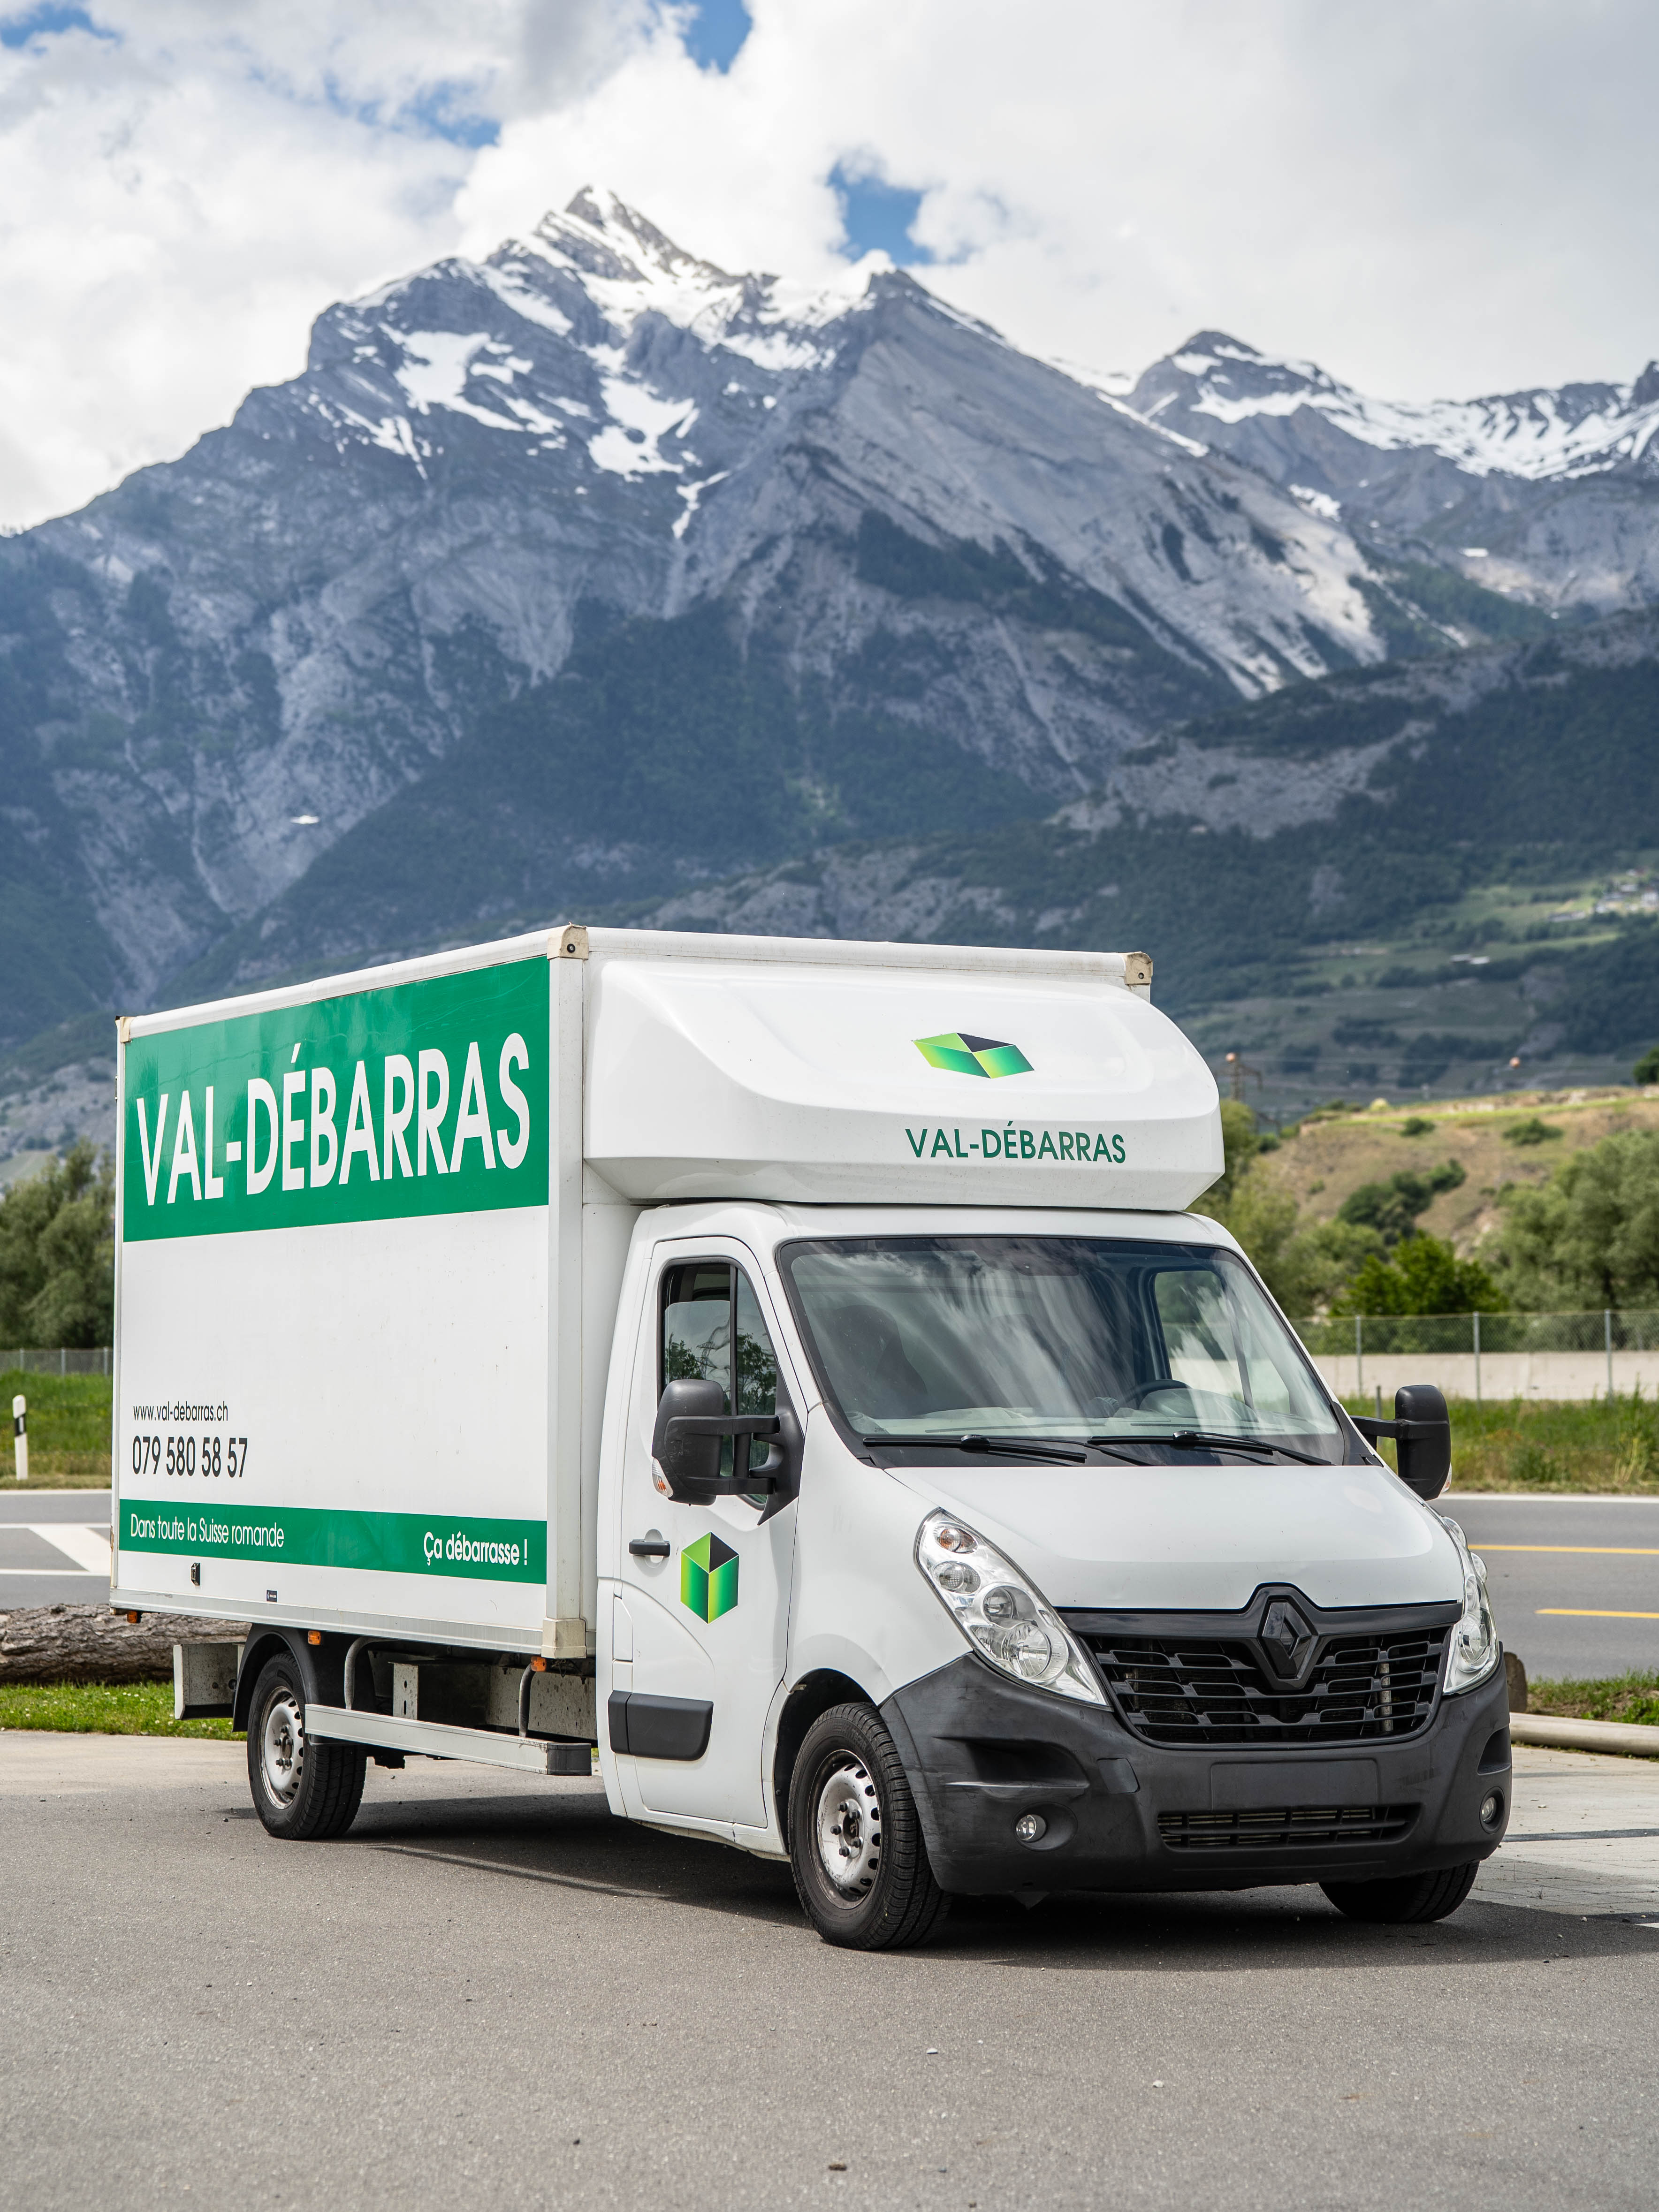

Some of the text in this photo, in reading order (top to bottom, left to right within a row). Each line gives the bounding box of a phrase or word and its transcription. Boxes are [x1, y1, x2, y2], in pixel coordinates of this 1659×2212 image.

[136, 1033, 530, 1206] VAL-DÉBARRAS
[905, 1120, 1126, 1163] VAL-DÉBARRAS
[133, 1400, 228, 1421] www.val-debarras.ch
[132, 1435, 248, 1478] 079 580 58 57
[130, 1513, 284, 1548] Dans toute la Suisse romande
[423, 1531, 527, 1566] Ça débarrasse !
